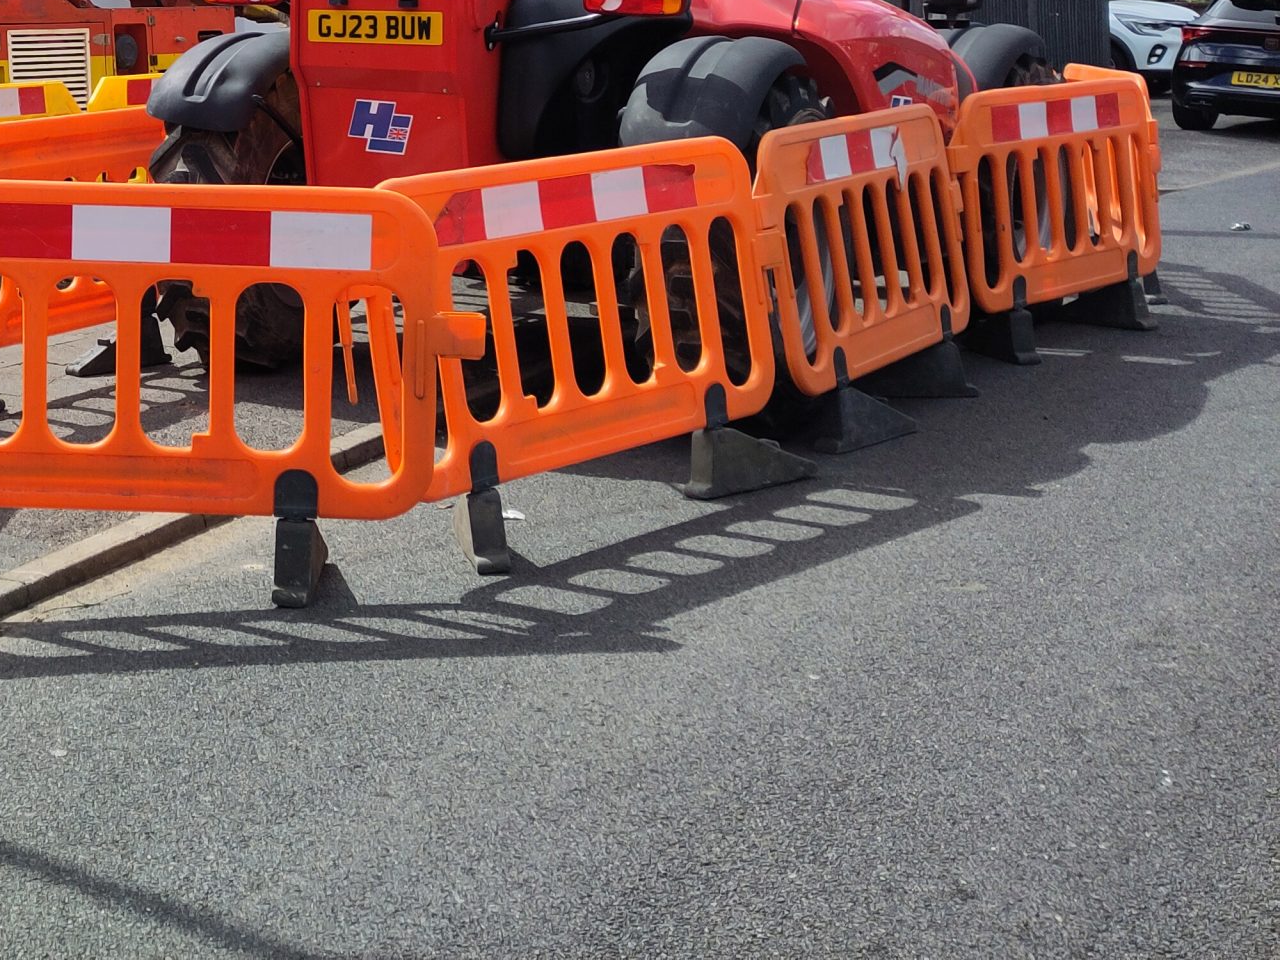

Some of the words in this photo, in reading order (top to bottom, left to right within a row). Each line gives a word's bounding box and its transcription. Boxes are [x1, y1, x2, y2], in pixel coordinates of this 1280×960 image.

[318, 14, 378, 39] GJ23
[385, 15, 432, 40] BUW
[1237, 73, 1269, 85] LD24
